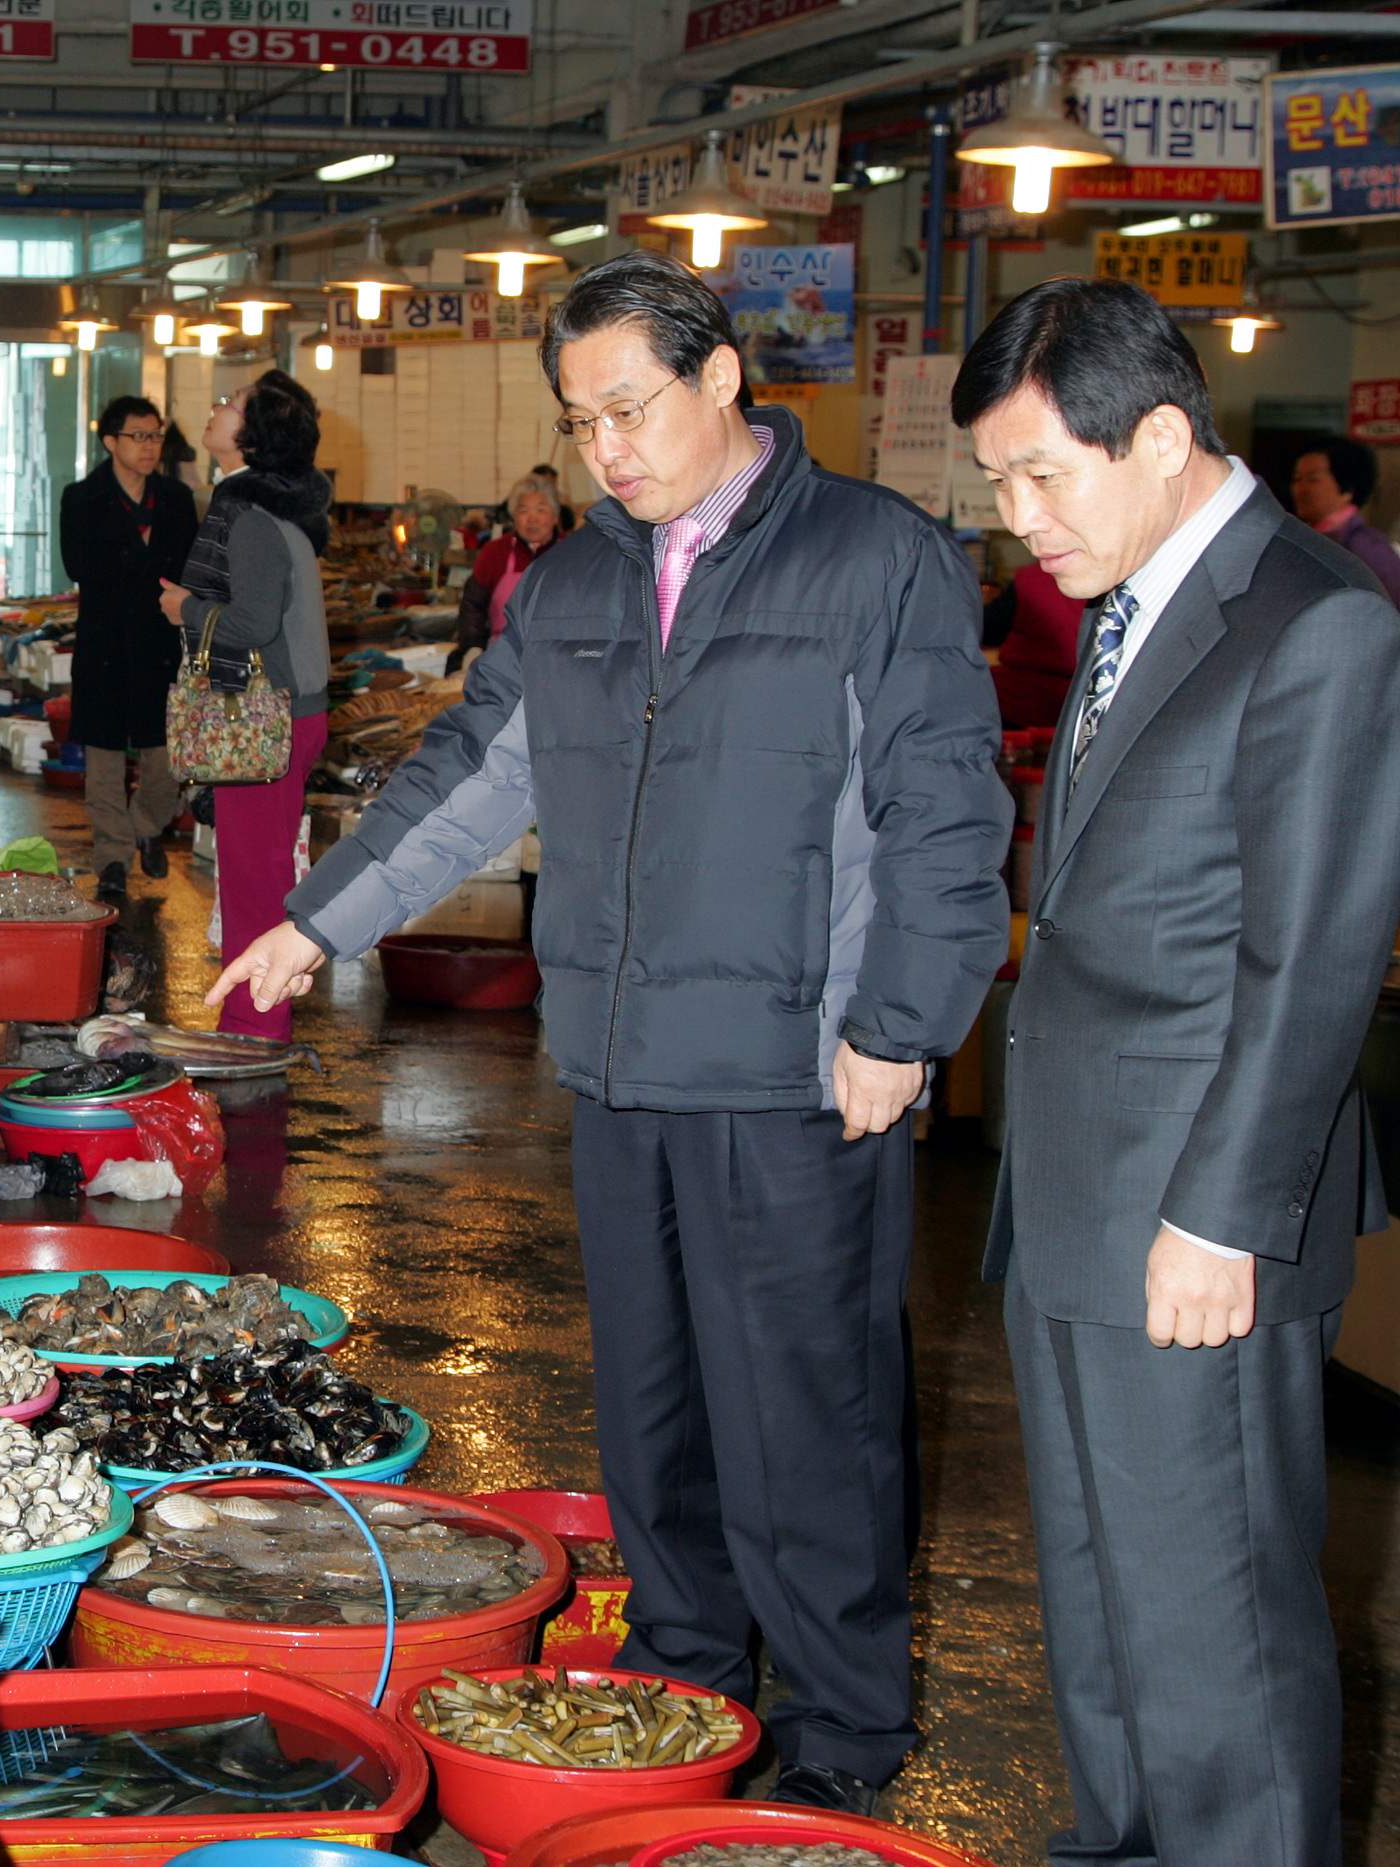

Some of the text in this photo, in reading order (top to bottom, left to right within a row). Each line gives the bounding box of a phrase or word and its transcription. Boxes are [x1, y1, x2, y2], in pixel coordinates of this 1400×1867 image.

[168, 27, 499, 67] T.951-0448
[1286, 88, 1371, 152] 문산
[740, 252, 832, 286] 인수산
